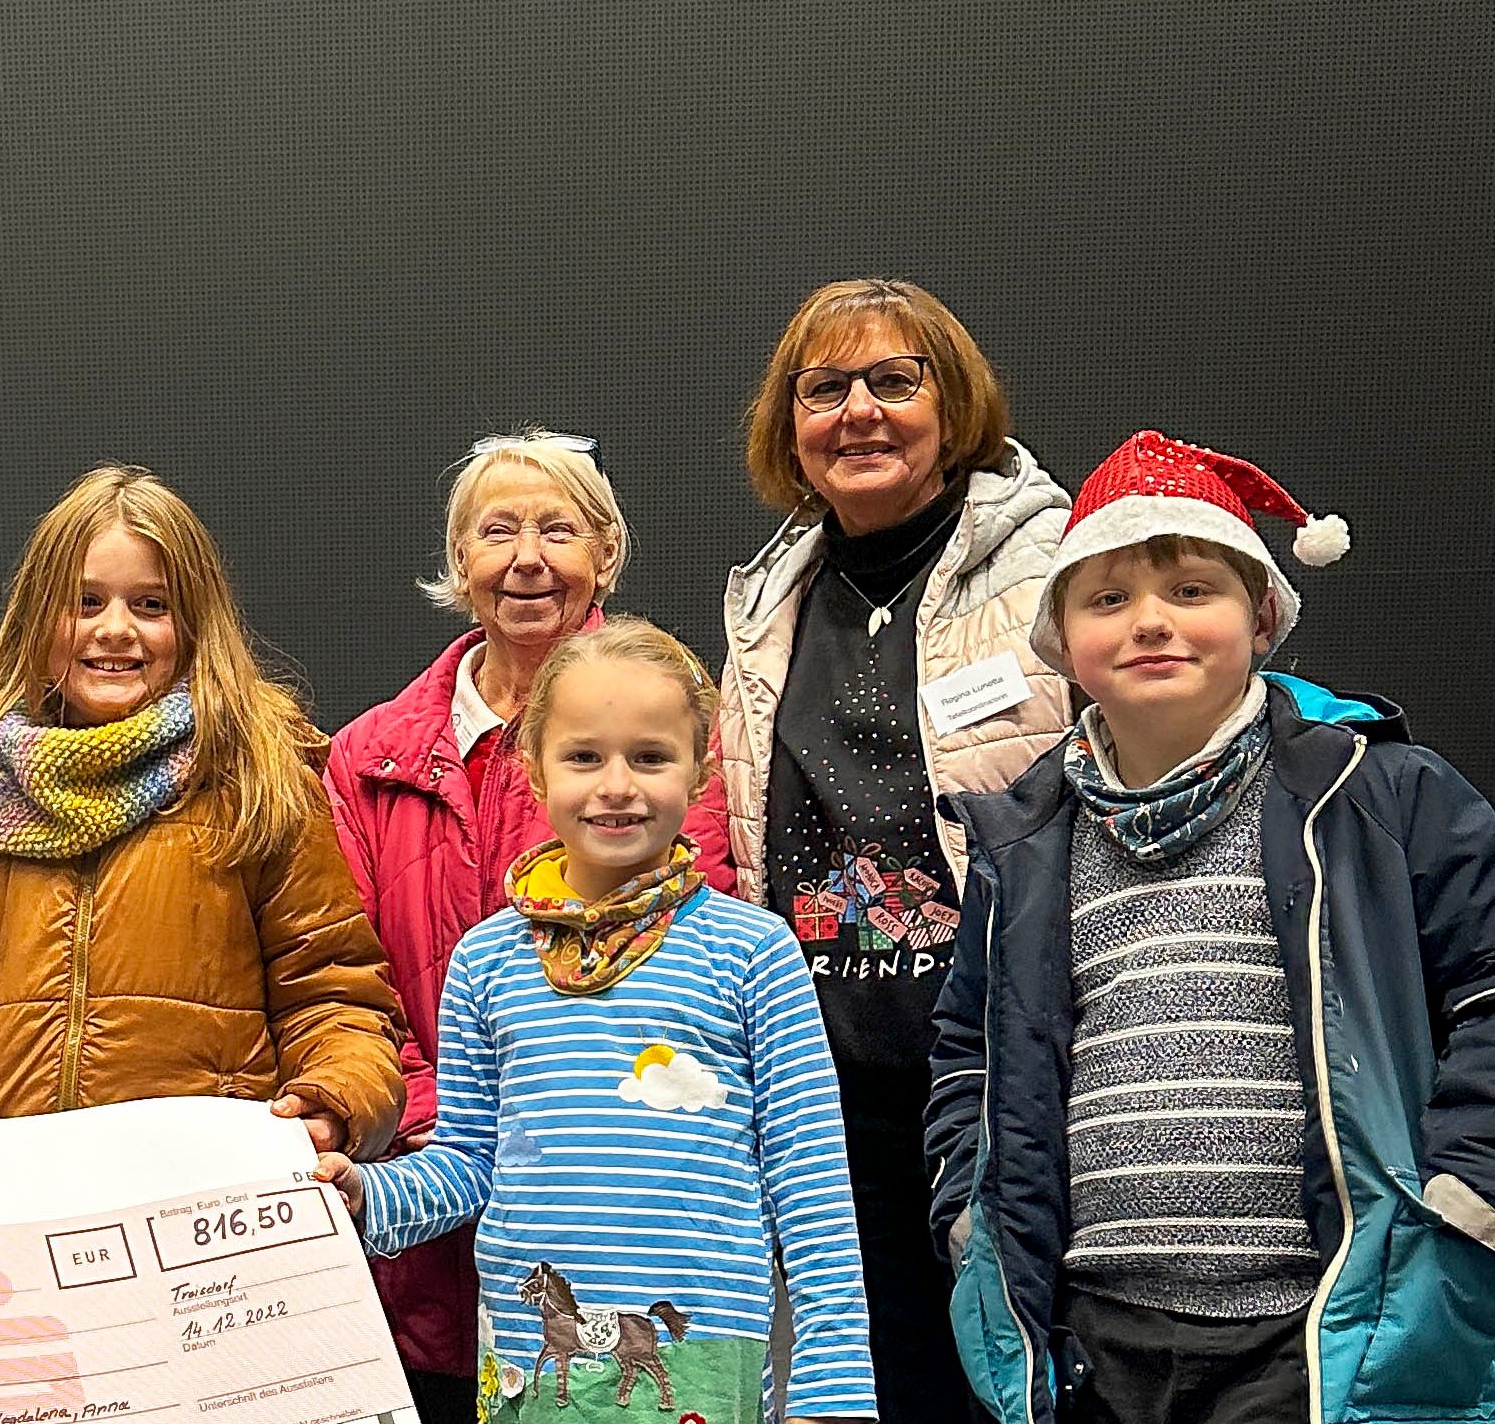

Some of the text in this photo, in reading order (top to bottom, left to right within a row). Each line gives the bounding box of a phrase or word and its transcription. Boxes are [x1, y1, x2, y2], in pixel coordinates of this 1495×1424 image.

[874, 912, 900, 933] ROSS
[929, 907, 955, 921] JOEY
[194, 1201, 293, 1246] 816,50
[72, 1248, 111, 1266] EUR
[171, 1275, 236, 1302] Troisdorf
[182, 1339, 216, 1353] Datum
[199, 1375, 334, 1412] Unterschrift des Ausstellers
[81, 1400, 131, 1419] Anna
